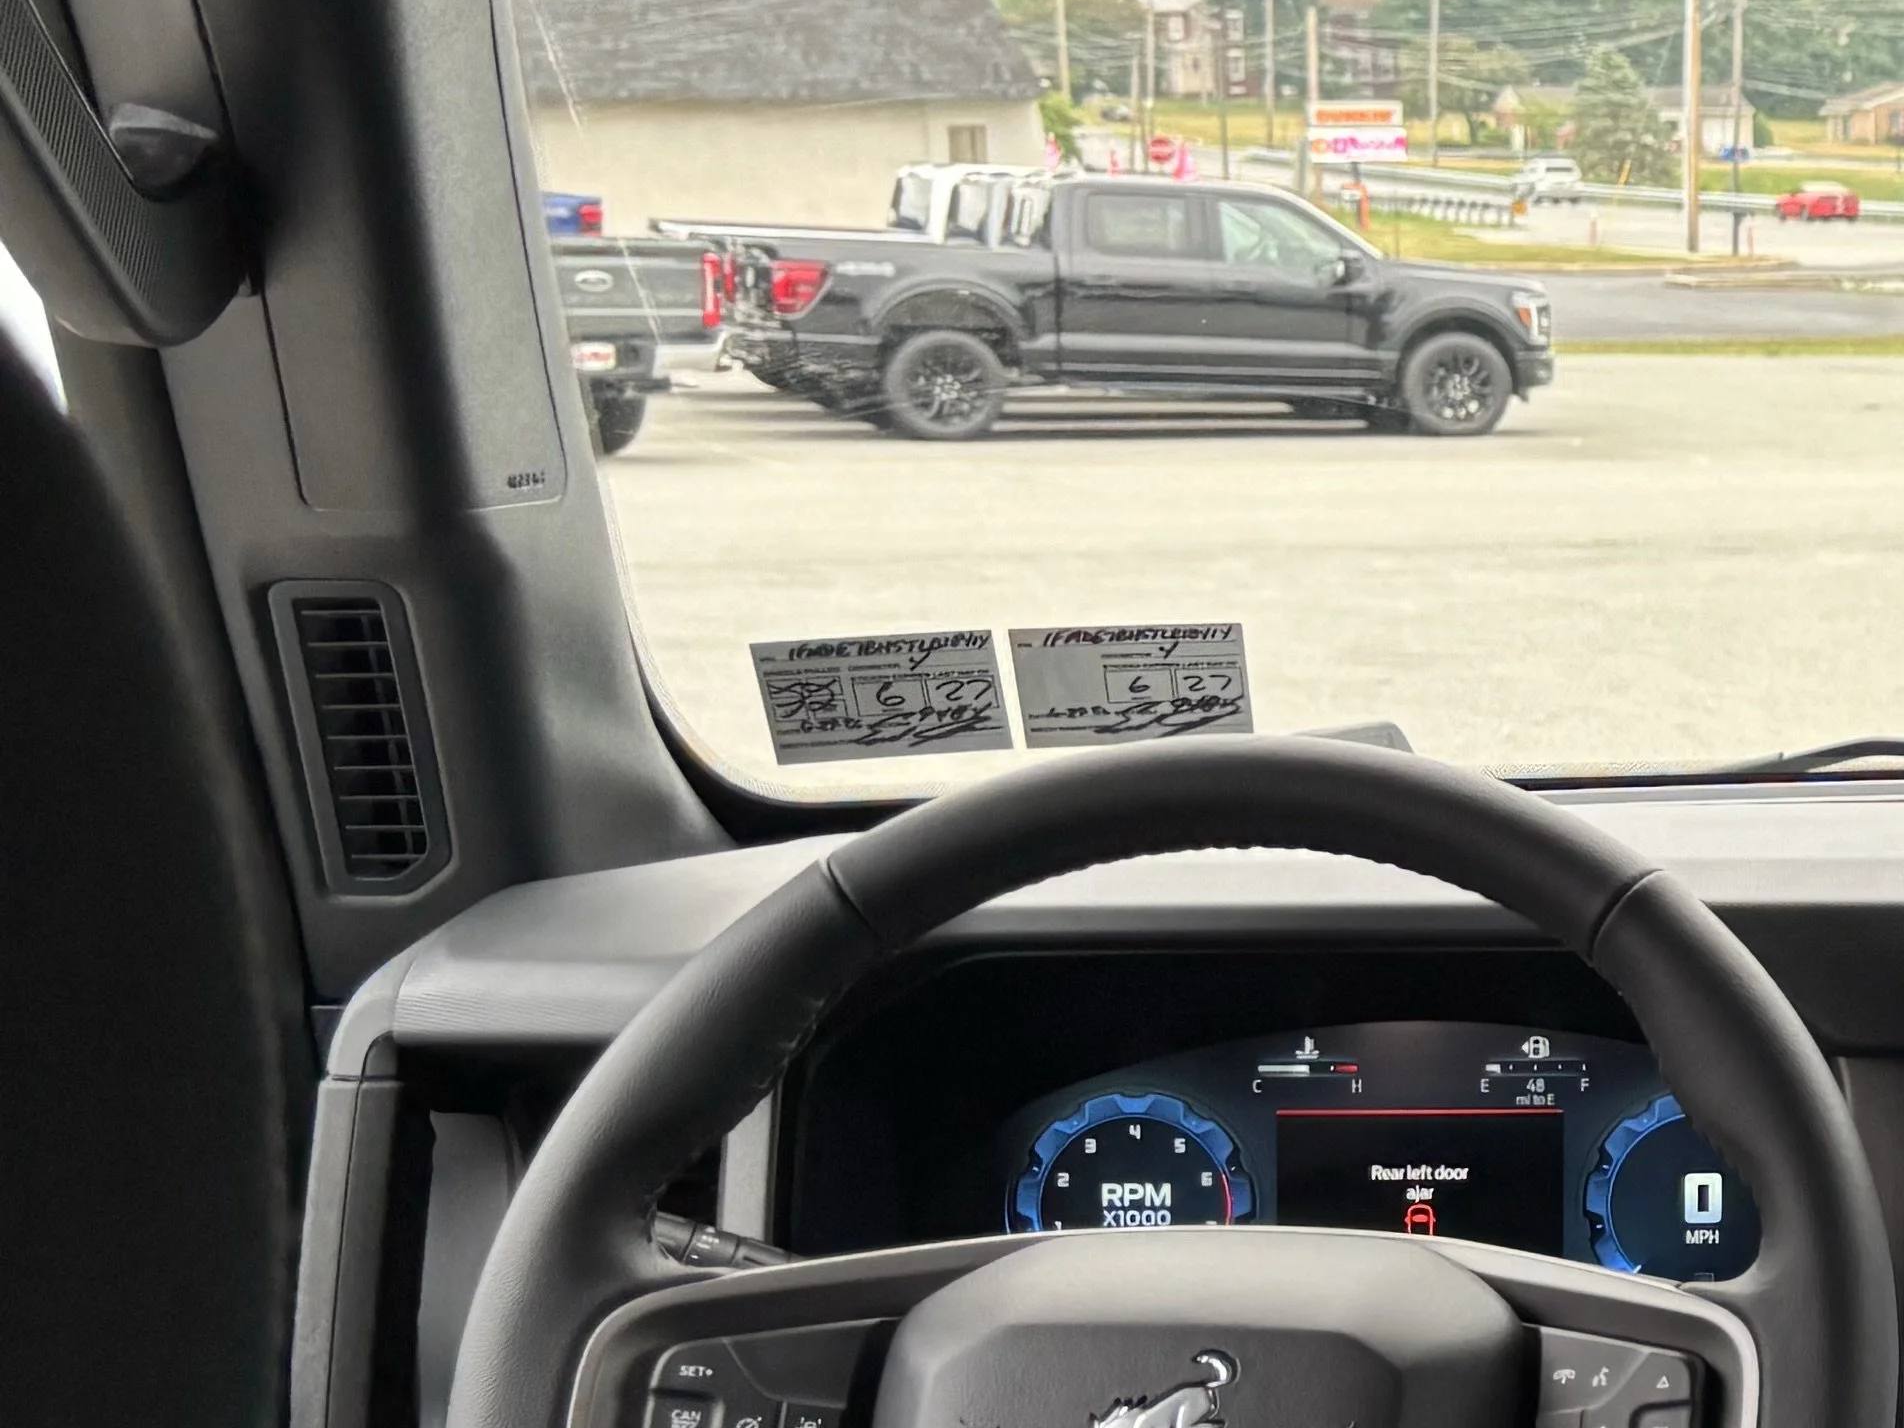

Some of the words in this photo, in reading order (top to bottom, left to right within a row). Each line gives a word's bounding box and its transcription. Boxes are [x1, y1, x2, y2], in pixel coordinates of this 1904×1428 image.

[1128, 675, 1151, 694] 6
[1183, 674, 1233, 692] 27
[876, 681, 905, 707] 6
[935, 679, 993, 701] 27
[1252, 1079, 1262, 1093] C
[1351, 1079, 1362, 1093] H
[1480, 1079, 1490, 1093] E
[1525, 1078, 1546, 1093] 48
[1580, 1078, 1590, 1092] F
[1546, 1093, 1555, 1106] E
[1129, 1124, 1141, 1140] 4
[1085, 1138, 1097, 1154] 3
[1173, 1138, 1186, 1154] 5
[1057, 1172, 1070, 1188] 2
[1201, 1172, 1213, 1187] 6
[1371, 1164, 1404, 1181] Rear
[1406, 1163, 1433, 1181] left
[1434, 1164, 1469, 1181] door
[1101, 1182, 1172, 1208] RPM
[1406, 1184, 1435, 1203] ajar
[1684, 1172, 1723, 1224] 0
[1102, 1209, 1172, 1227] X1000
[1685, 1229, 1720, 1245] MPH
[671, 1409, 702, 1422] CAN
